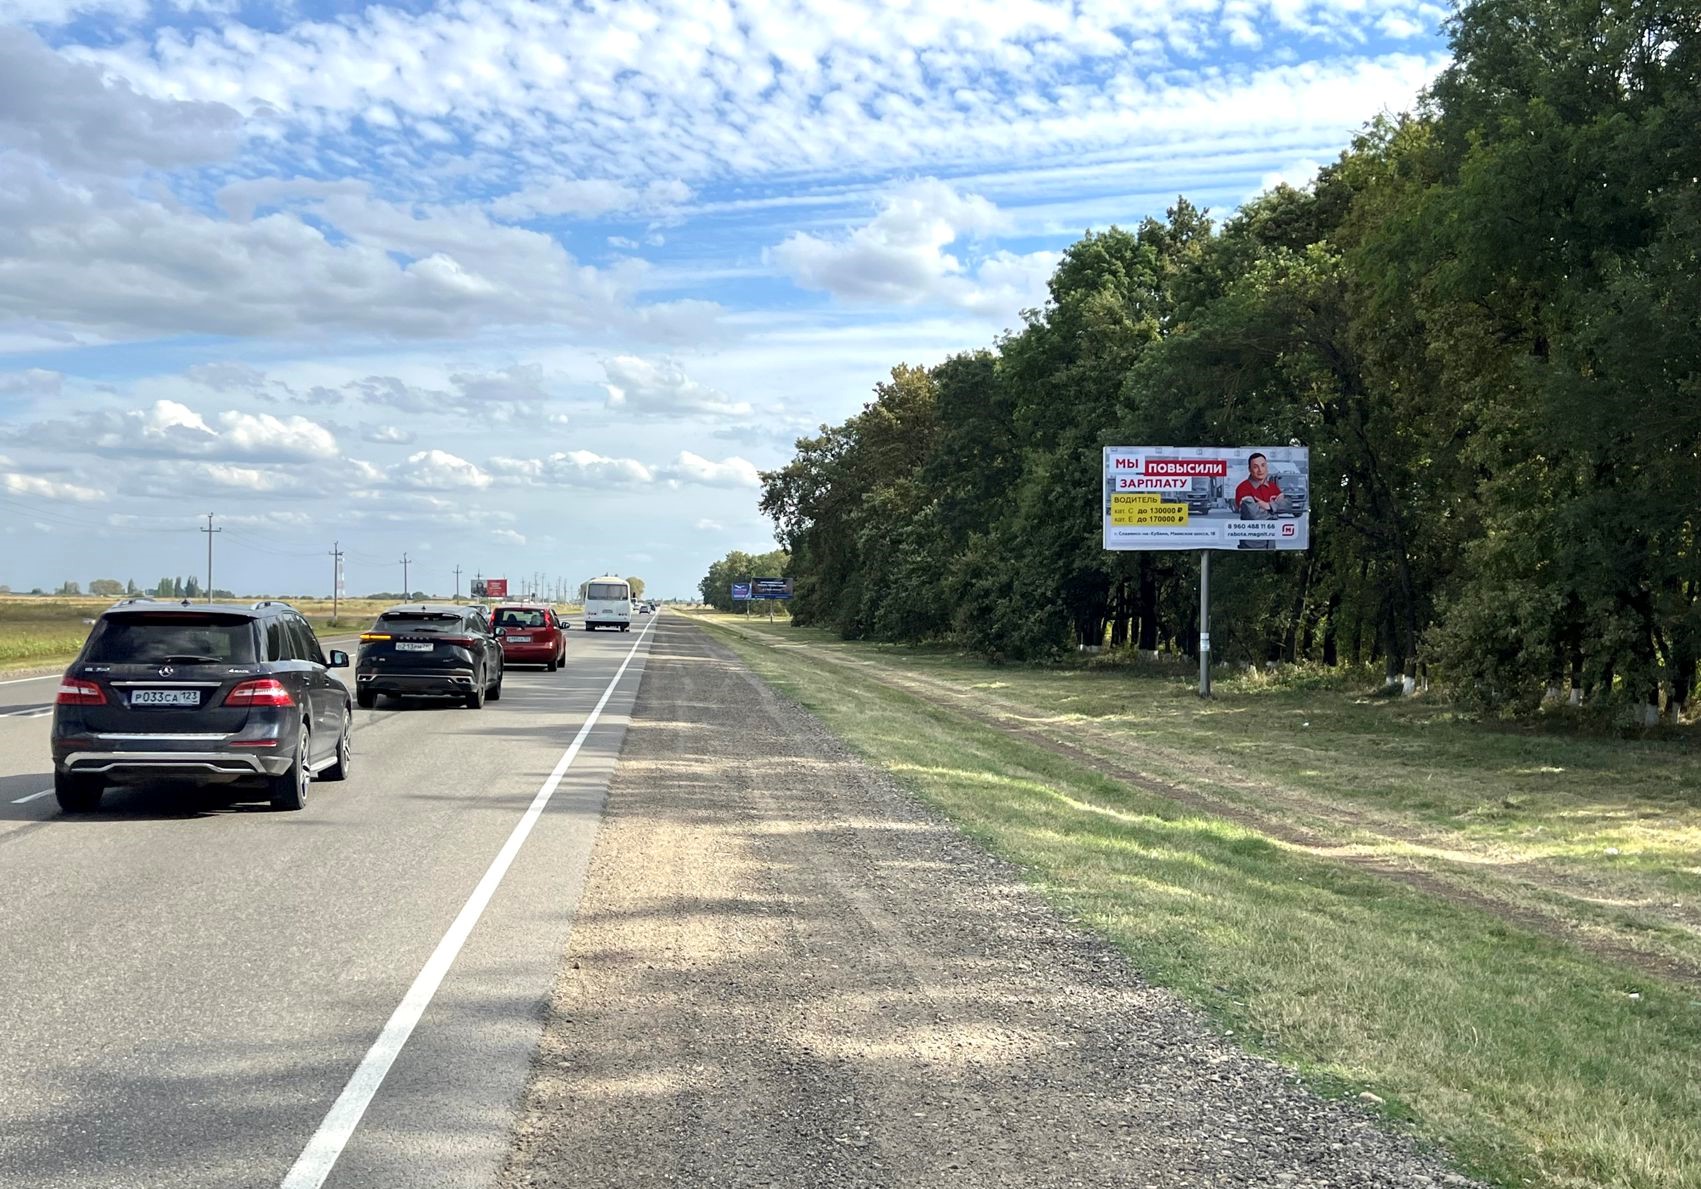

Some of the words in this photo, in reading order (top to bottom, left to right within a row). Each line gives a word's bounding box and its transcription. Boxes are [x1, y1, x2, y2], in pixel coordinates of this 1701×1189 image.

[1115, 458, 1139, 469] МЫ
[1148, 463, 1222, 474] ПОВЫСИЛИ
[1119, 479, 1188, 488] ЗАРПЛАТУ
[1113, 496, 1158, 504] ВОДИТЕЛЬ
[180, 691, 197, 700] 123
